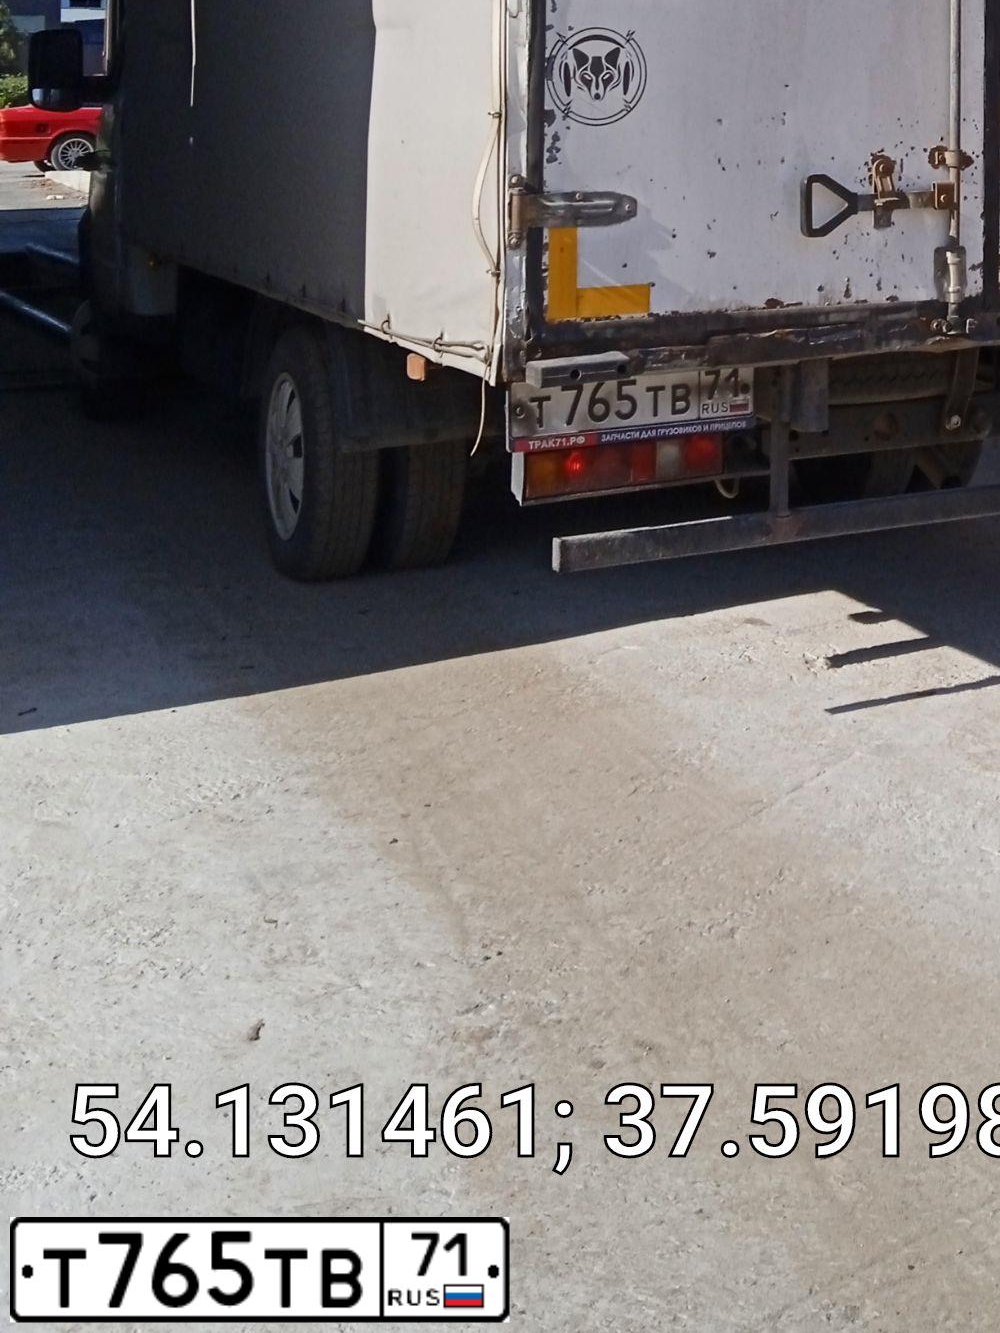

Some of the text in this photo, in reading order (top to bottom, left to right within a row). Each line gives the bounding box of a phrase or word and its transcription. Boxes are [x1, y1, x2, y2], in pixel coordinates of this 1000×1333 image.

[704, 369, 741, 400] 71
[701, 401, 729, 415] RUS
[601, 431, 639, 442] ЗАПЧАСТИ
[640, 428, 656, 439] ДЛЯ
[656, 424, 701, 437] ГРУЗОВИКОВ
[528, 435, 586, 450] ТРАК71.РФ
